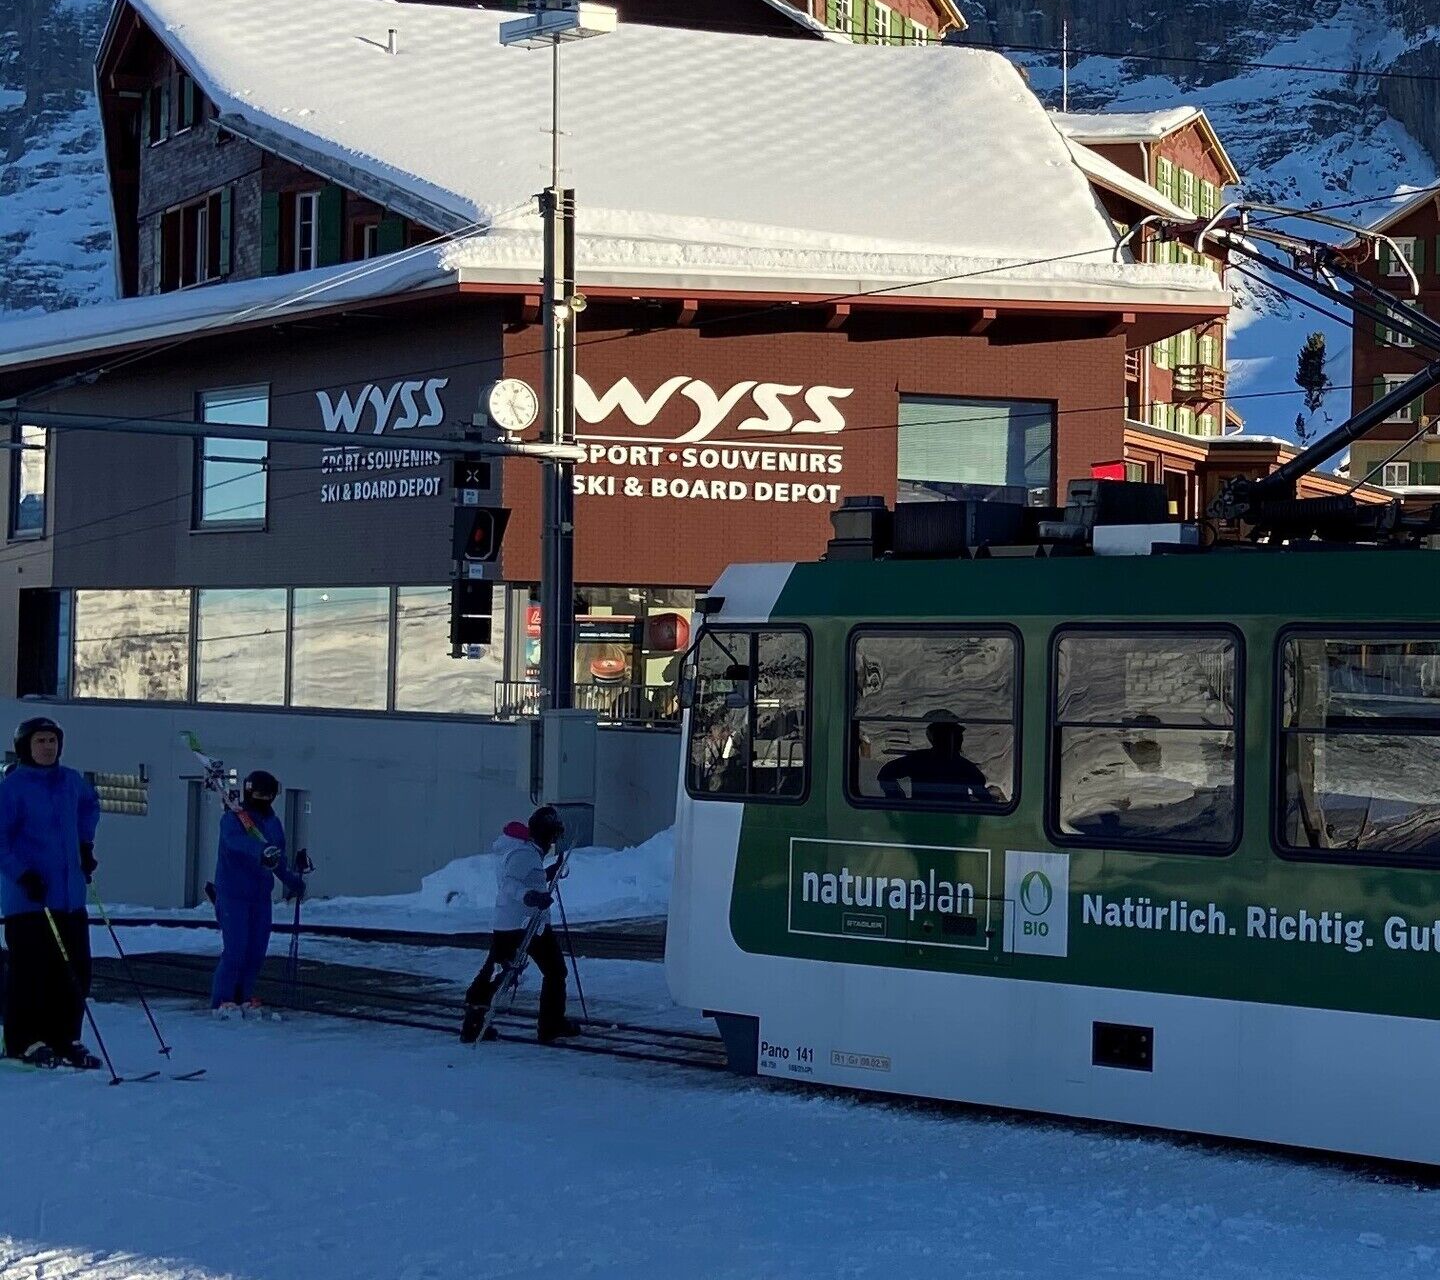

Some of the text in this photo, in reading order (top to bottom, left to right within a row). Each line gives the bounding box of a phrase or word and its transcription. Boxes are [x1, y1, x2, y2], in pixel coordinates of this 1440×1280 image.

[321, 483, 340, 503] SKI
[343, 483, 352, 501] &
[354, 479, 397, 500] BOARD
[399, 477, 441, 498] DEPOT
[573, 475, 842, 504] SKI & BOARD DEPOT
[802, 866, 975, 921] naturaplan
[1023, 919, 1049, 937] BIO
[1081, 892, 1237, 938] Natürlich.
[1246, 905, 1374, 954] Richtig.
[761, 1041, 814, 1063] Pano 141
